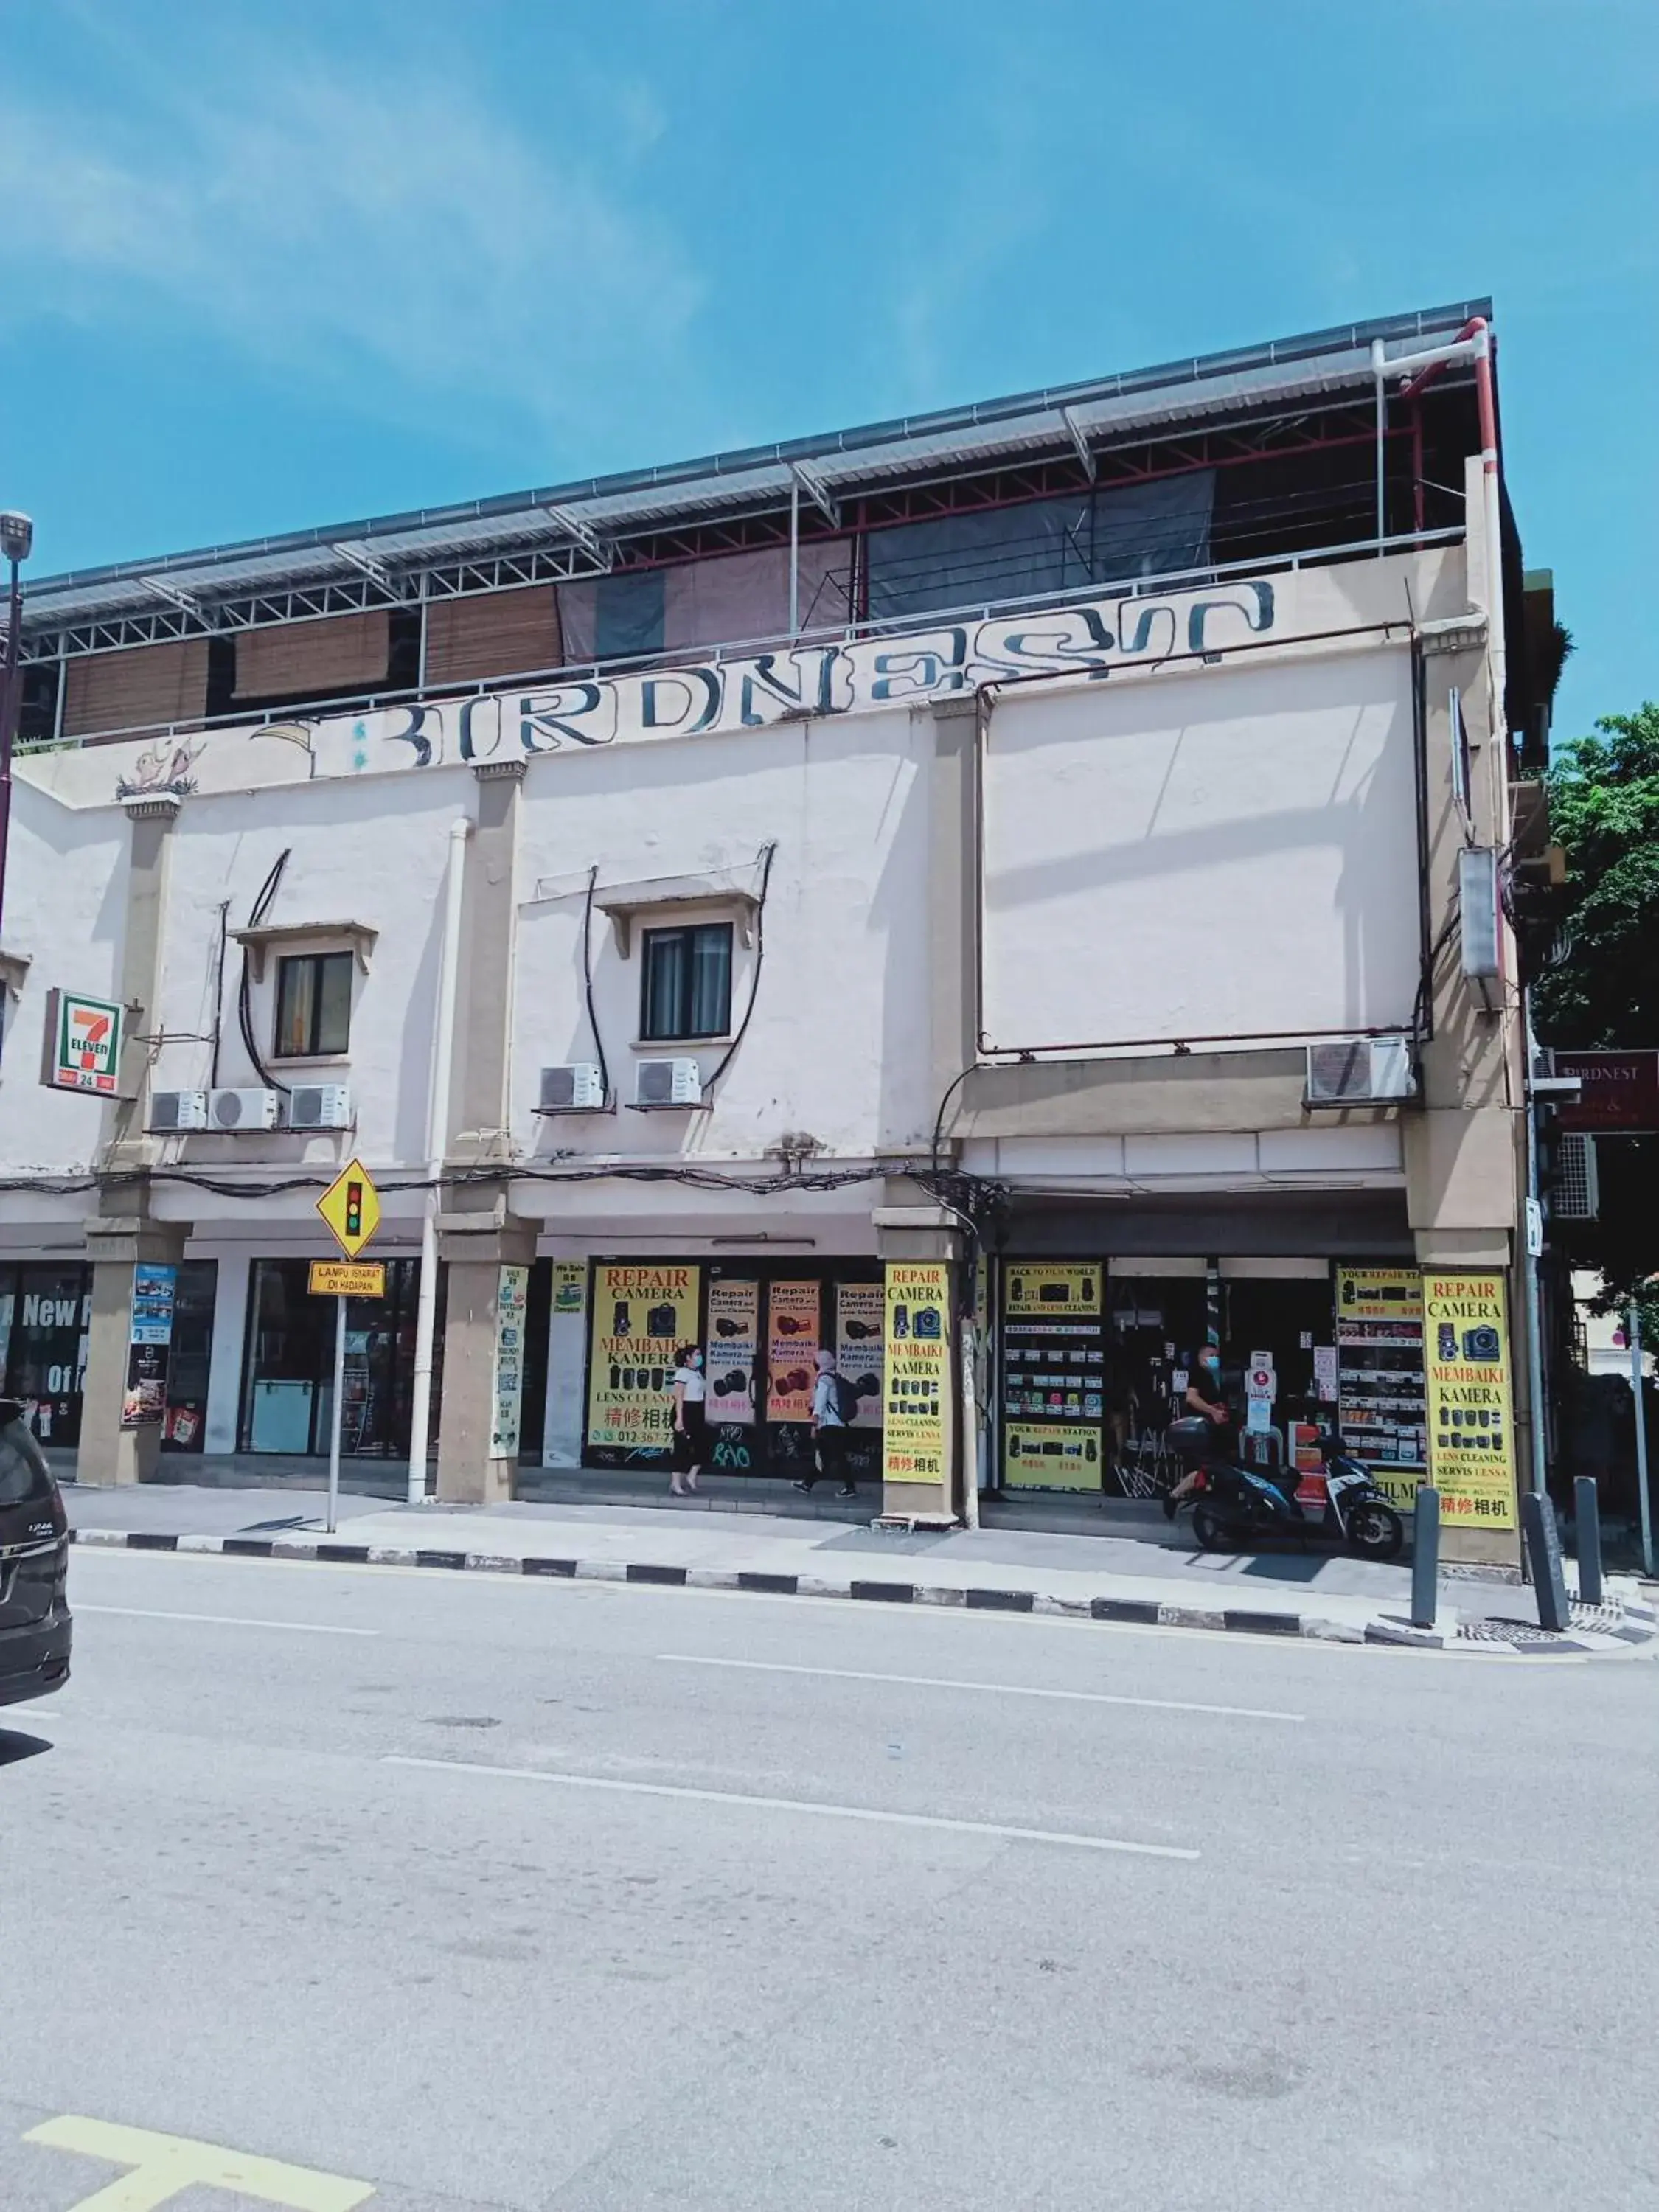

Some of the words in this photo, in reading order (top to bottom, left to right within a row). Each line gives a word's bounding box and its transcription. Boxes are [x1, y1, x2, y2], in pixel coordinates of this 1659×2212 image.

[311, 580, 1275, 779] BIRDNEST
[80, 1074, 93, 1086] 24
[318, 1267, 349, 1278] LAMPU
[352, 1268, 380, 1278] ISYARAT
[607, 1269, 689, 1287] REPAIR
[893, 1270, 941, 1284] REPAIR
[328, 1279, 338, 1289] DI
[340, 1281, 374, 1290] HADAPAN
[772, 1287, 815, 1295] Repair
[1433, 1282, 1495, 1298] REPAIR
[611, 1287, 684, 1300] CAMERA
[712, 1289, 754, 1298] Repair
[771, 1295, 804, 1304] Camera
[887, 1287, 944, 1301] CAMERA
[710, 1298, 742, 1306] Camera
[22, 1294, 77, 1326] New
[1428, 1301, 1501, 1318] CAMERA
[840, 1343, 883, 1352] Membaik
[888, 1343, 943, 1357] MEMBAIKI
[608, 1352, 676, 1365] KAMER
[893, 1361, 940, 1375] KAMERA
[1433, 1366, 1505, 1383] MEMBAIKI
[47, 1365, 72, 1393] Of
[597, 1391, 625, 1402] LENS
[627, 1393, 677, 1404] CLEANIN
[1440, 1387, 1502, 1404] KAMERA
[905, 1417, 942, 1427] CLEANING
[887, 1430, 914, 1439] SERVIS
[1009, 1425, 1032, 1433] YOUR
[1062, 1427, 1097, 1436] STATION
[1437, 1451, 1459, 1462] LENS
[1461, 1453, 1507, 1464] CLEANING
[1437, 1465, 1473, 1476] SERVIS
[1475, 1467, 1508, 1478] LENSA
[1440, 1495, 1509, 1517] 精修相机
